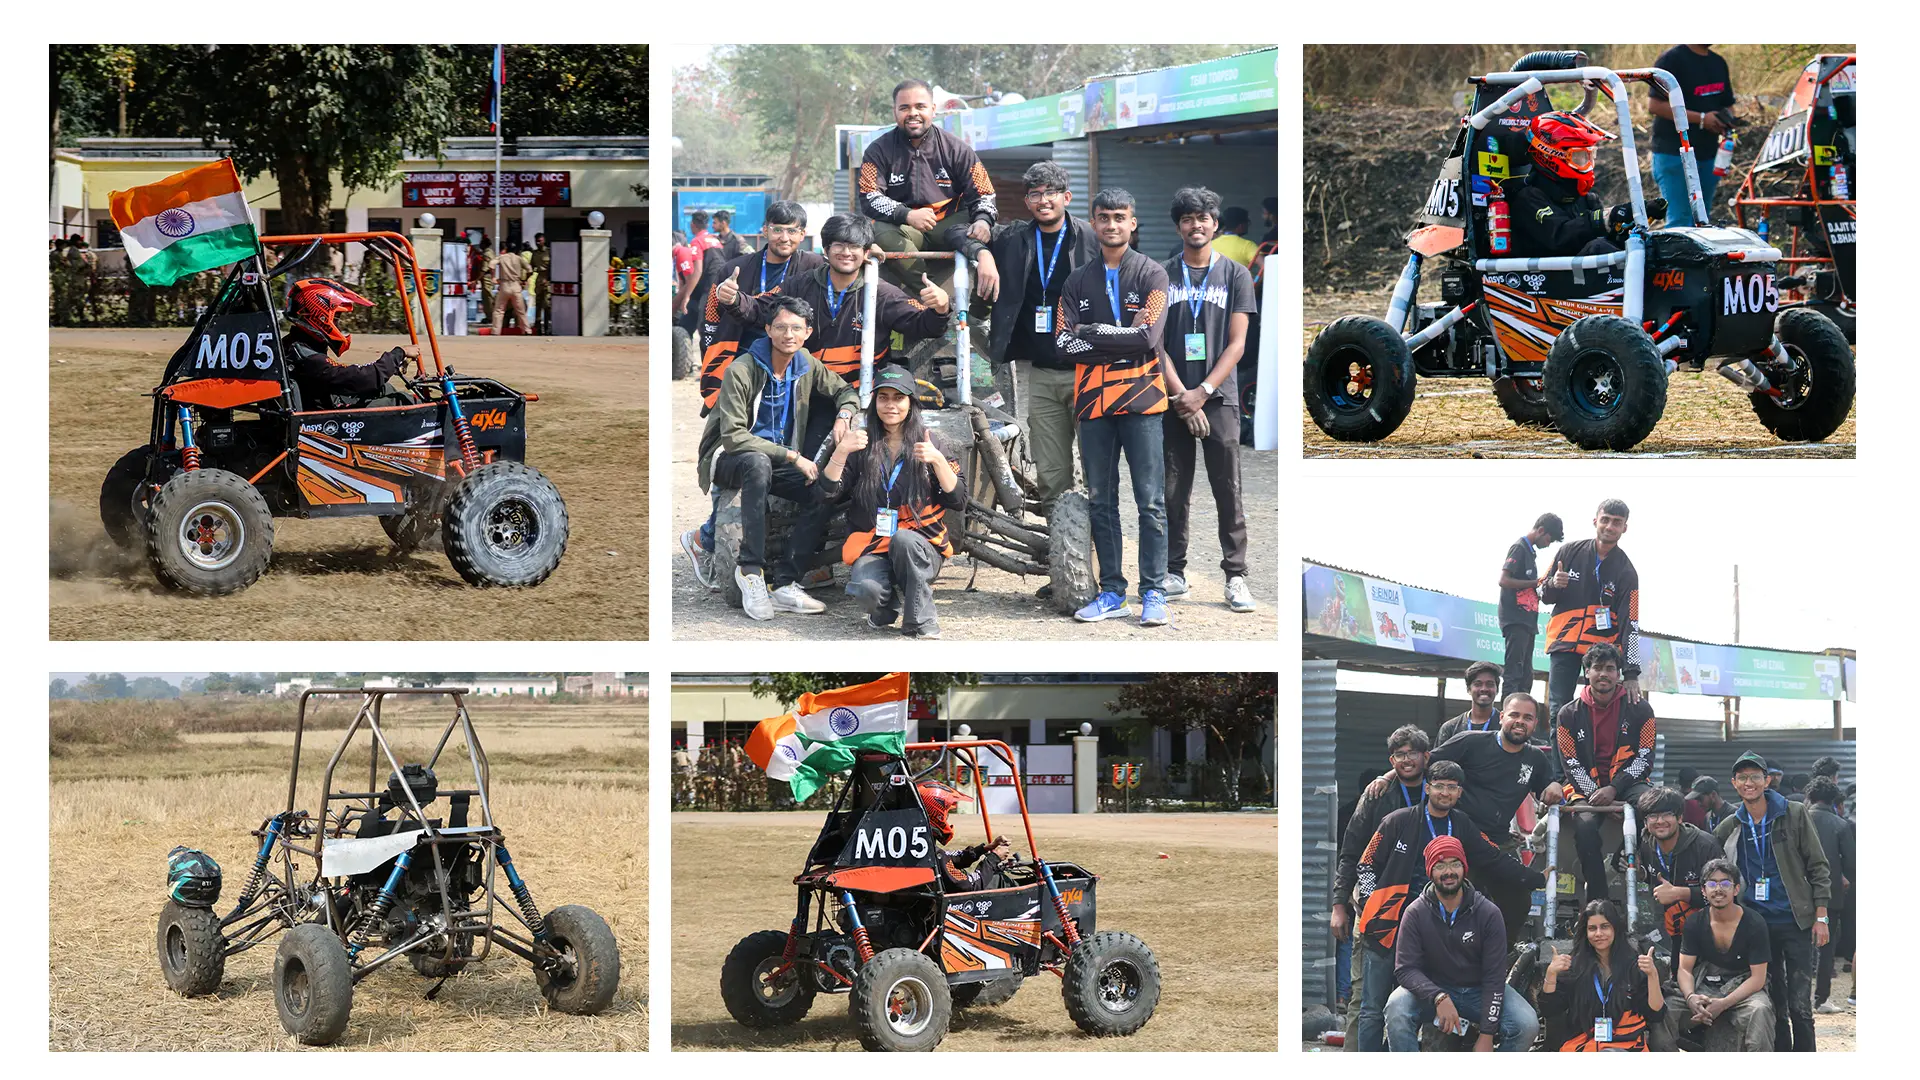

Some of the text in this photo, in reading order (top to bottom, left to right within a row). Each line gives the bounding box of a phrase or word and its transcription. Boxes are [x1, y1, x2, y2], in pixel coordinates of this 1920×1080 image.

[519, 173, 538, 182] COY
[541, 173, 564, 182] NCC
[422, 187, 542, 197] UNITY AND DSCIPLINE
[1425, 178, 1459, 217] M05
[1482, 274, 1504, 285] Ansys
[1723, 273, 1779, 316] M05
[1555, 299, 1575, 308] TARUN
[1576, 303, 1598, 312] KUMAR
[195, 332, 274, 370] M05
[299, 422, 322, 433] Ansys
[1410, 620, 1429, 634] Speed
[1476, 638, 1491, 650] KCG
[854, 825, 929, 860] M05
